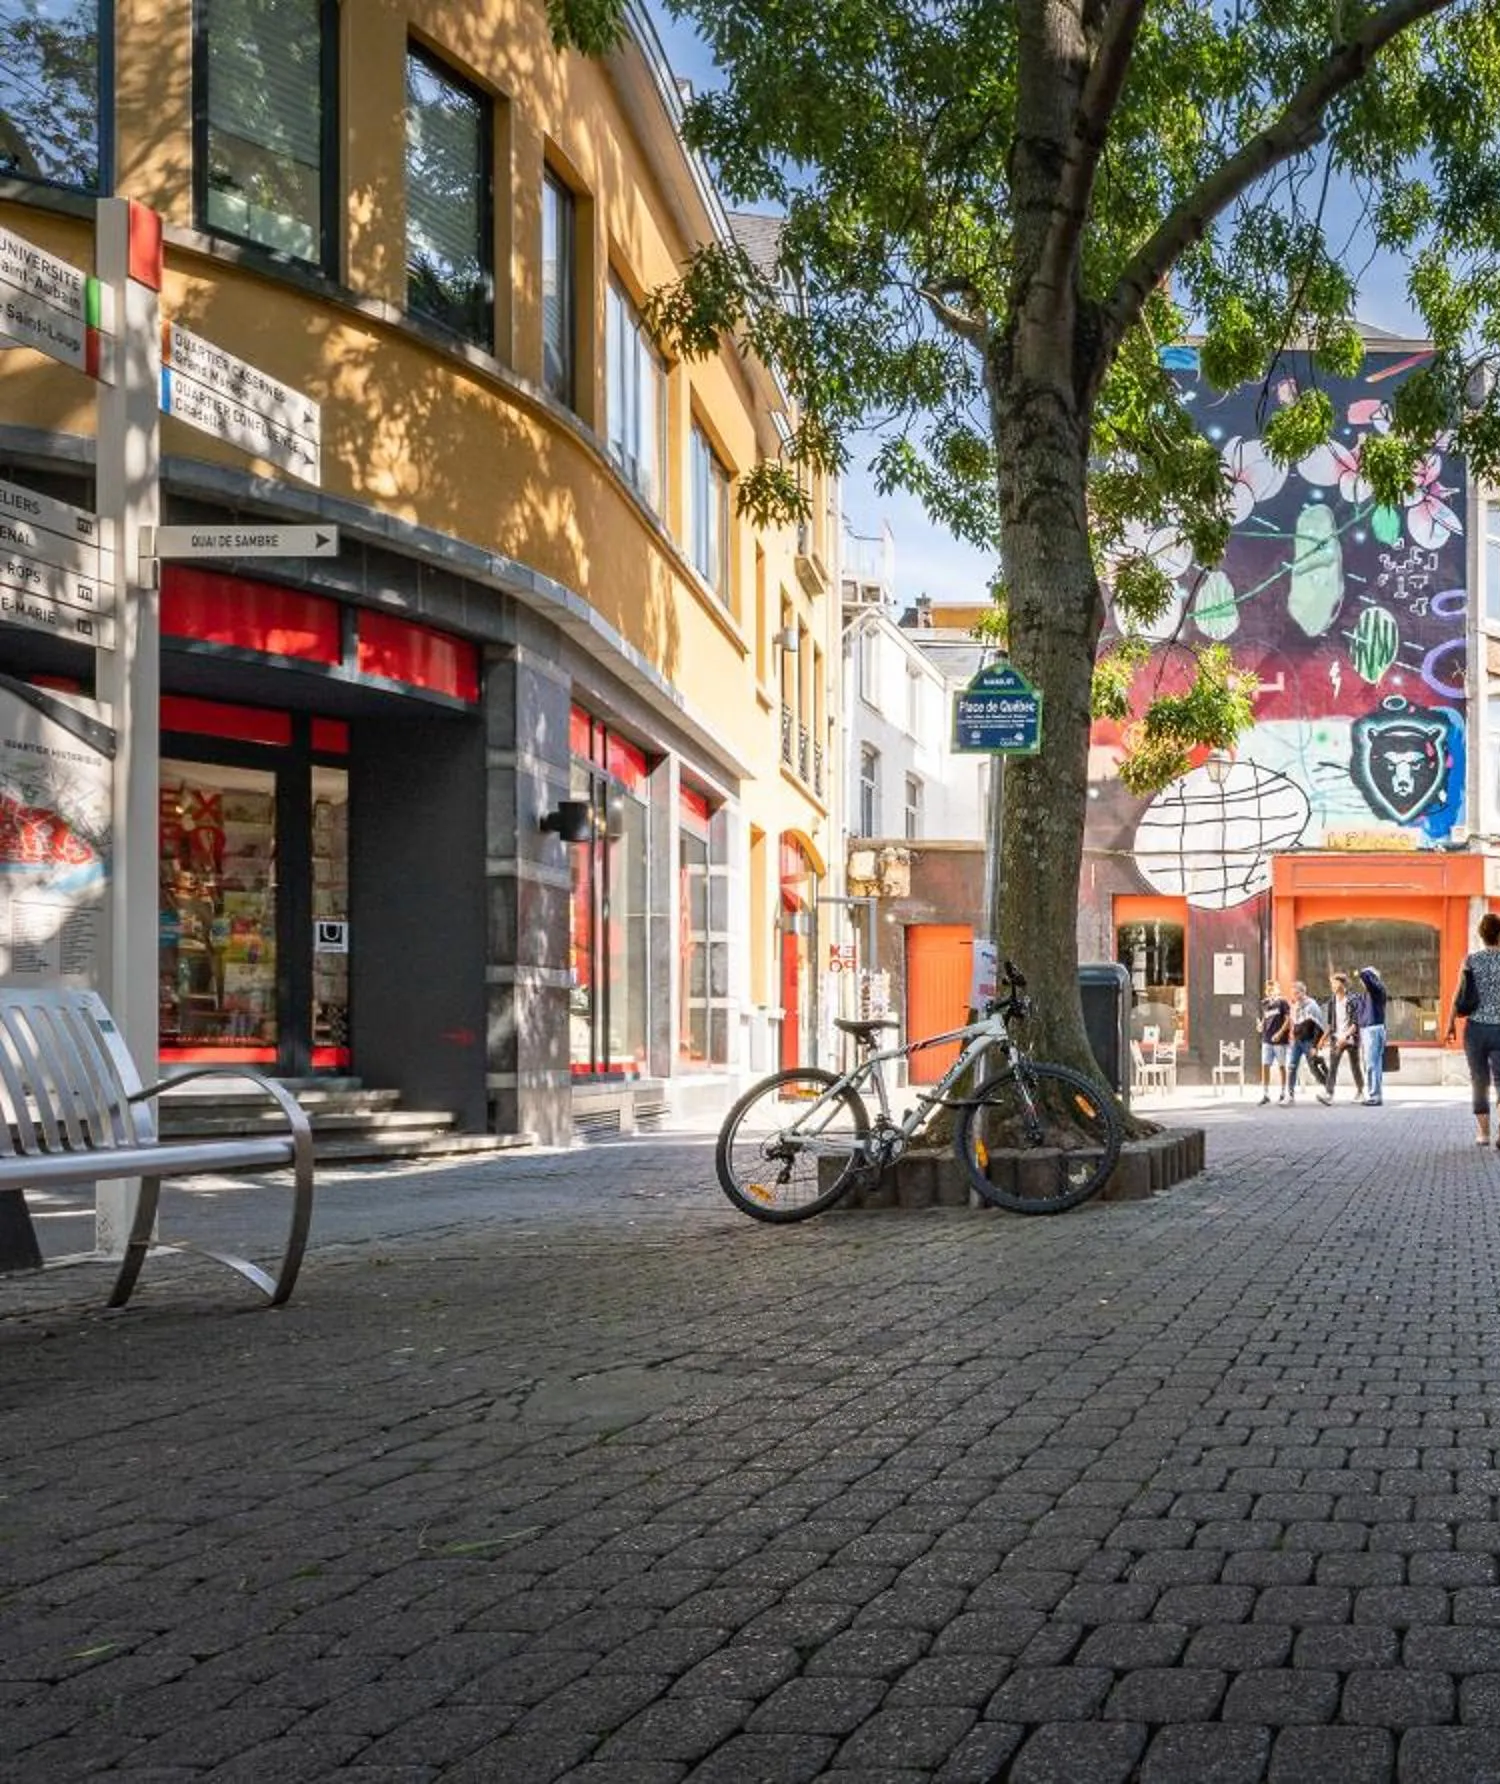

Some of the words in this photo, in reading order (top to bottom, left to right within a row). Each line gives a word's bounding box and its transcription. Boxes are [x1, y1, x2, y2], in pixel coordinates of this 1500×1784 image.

[191, 534, 216, 547] QUAI
[218, 534, 233, 547] DE
[234, 534, 279, 547] SAMBRE
[7, 561, 41, 584] ROPS
[959, 700, 985, 713] Place
[986, 699, 998, 713] de
[999, 699, 1037, 714] Québec
